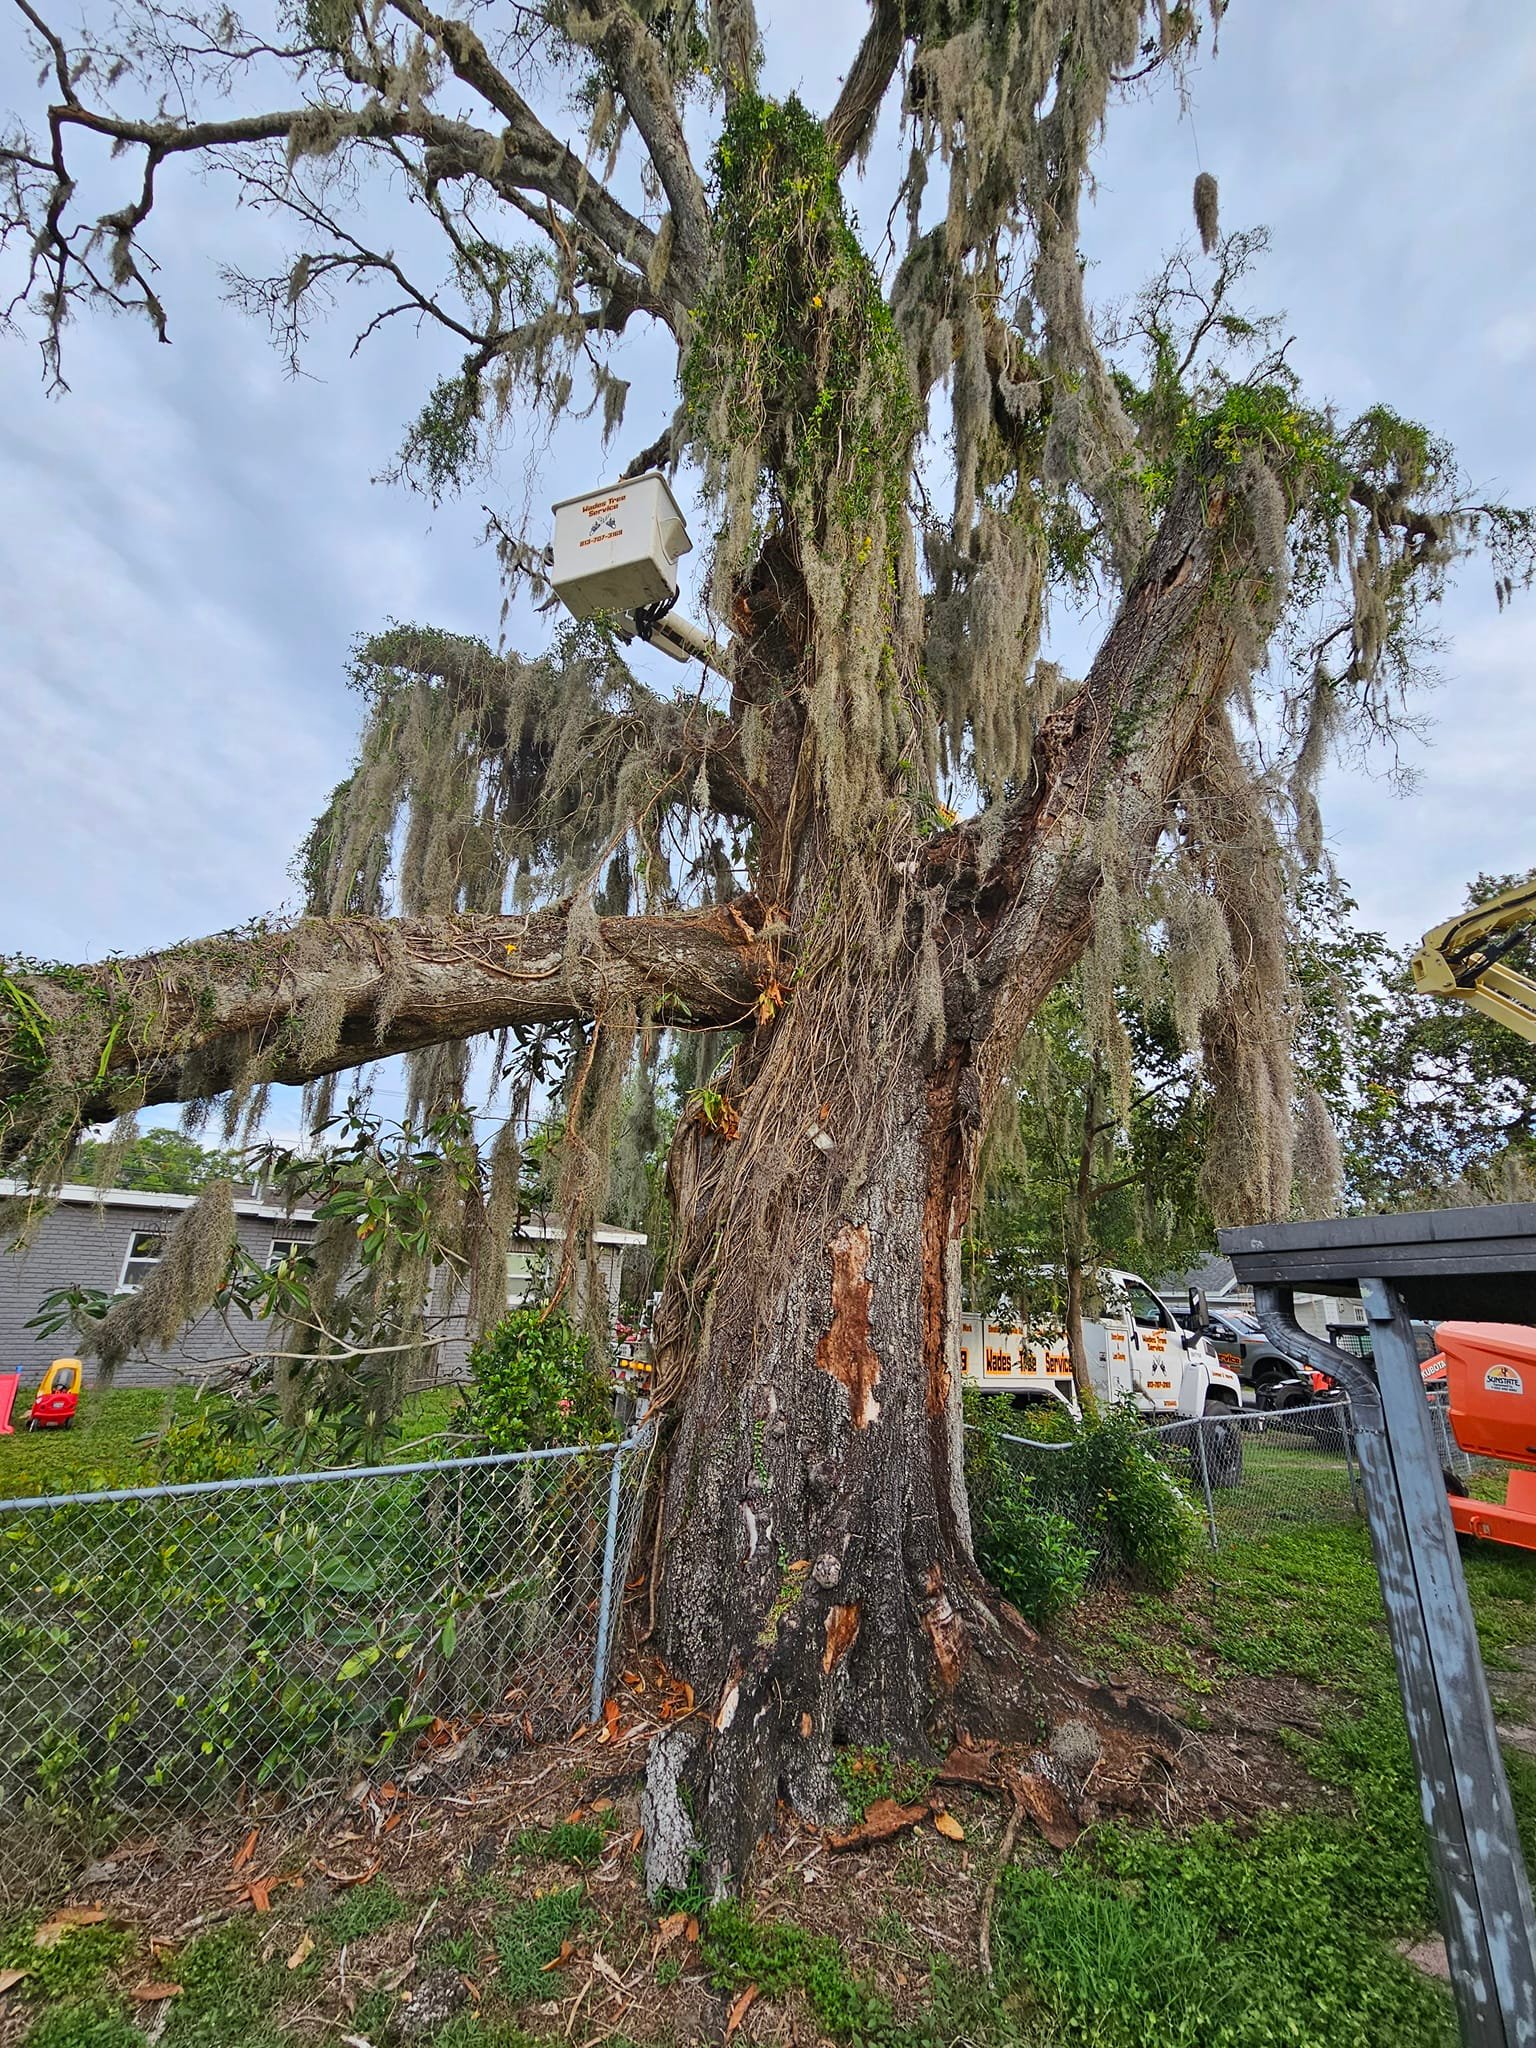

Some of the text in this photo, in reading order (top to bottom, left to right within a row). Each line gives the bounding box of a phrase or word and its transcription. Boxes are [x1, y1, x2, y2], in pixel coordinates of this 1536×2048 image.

[582, 495, 626, 513] Wades Tree
[588, 503, 619, 517] Service
[985, 1348, 1012, 1372] Wades
[1421, 1360, 1446, 1378] KUBOTA
[1486, 1375, 1520, 1387] SUNSTATE
